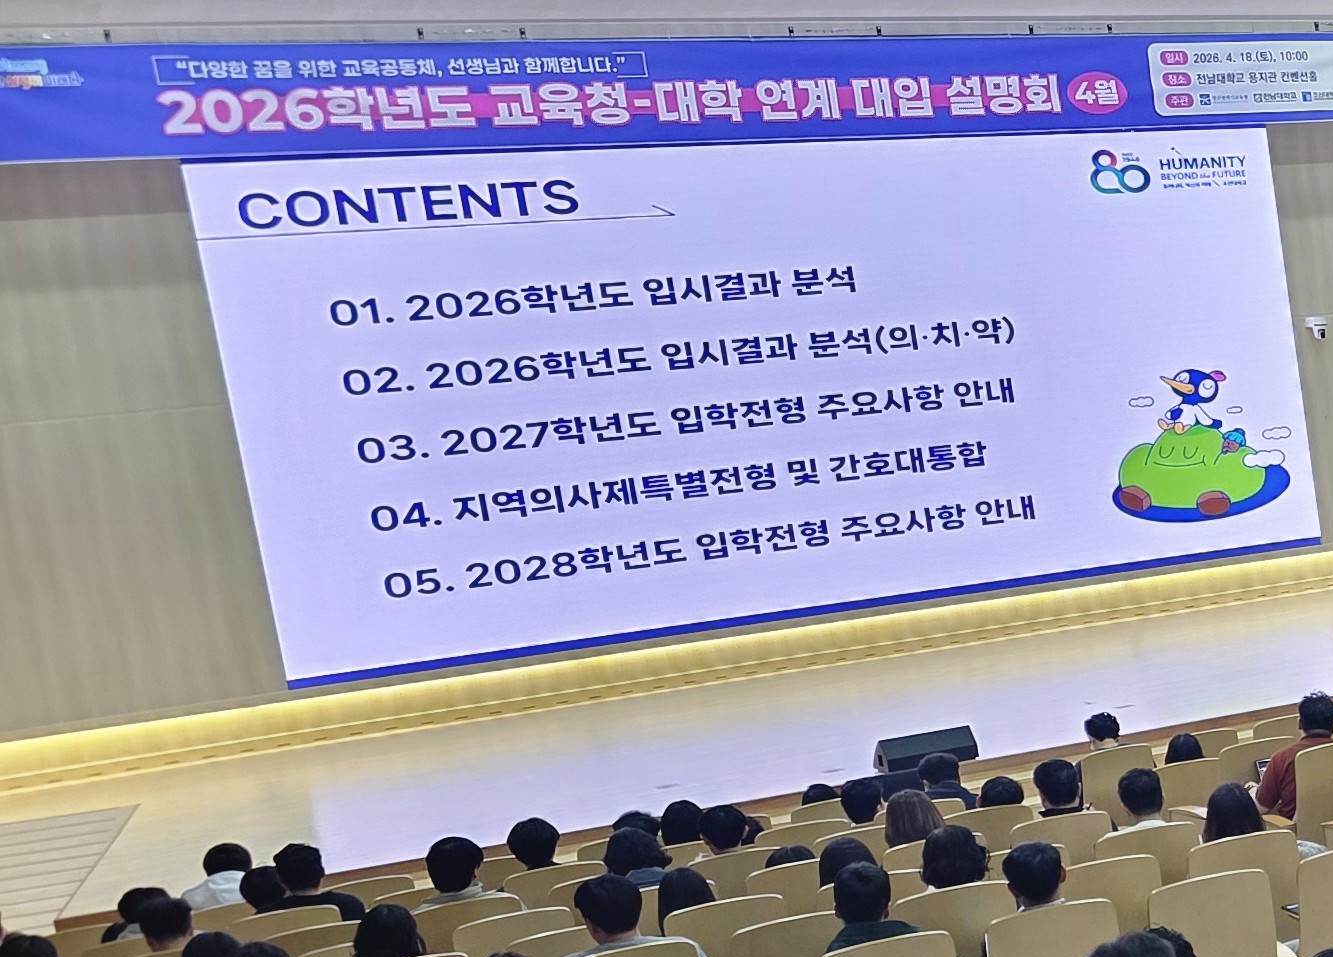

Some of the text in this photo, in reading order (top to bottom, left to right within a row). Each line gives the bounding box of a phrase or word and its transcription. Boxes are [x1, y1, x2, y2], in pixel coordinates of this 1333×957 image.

[176, 60, 248, 78] “다양한
[253, 60, 293, 79] 꿈을
[298, 59, 337, 78] 위한
[342, 58, 442, 78] 교육공동체,
[447, 57, 519, 76] 선생님과
[1193, 53, 1222, 63] 2026.
[1226, 53, 1236, 63] 4.
[1280, 51, 1308, 61] 10:00
[1196, 73, 1245, 84] 전남대학교
[1249, 71, 1277, 84] 용지관
[157, 73, 1120, 135] 2026학년도 교육청-대학 연계 대입 설명회 4월
[1159, 155, 1246, 170] HUMANITY
[1160, 173, 1198, 181] BEYOND
[1212, 170, 1246, 178] FUTURE
[239, 180, 578, 230] CONTENTS
[331, 266, 856, 325] 01. 2026학년도 입시결과 분석
[344, 367, 414, 395] 02.
[426, 347, 651, 389] 2026학년도
[661, 334, 797, 370] 입시결과
[358, 378, 1014, 463] 03. 2027학년도 입학전형 주요사항 안내
[371, 441, 986, 531] 04. 지역의사제특별전형 및 간호대통합
[385, 495, 1035, 598] 05. 2028학년도 입학전형 주요사항 안내
